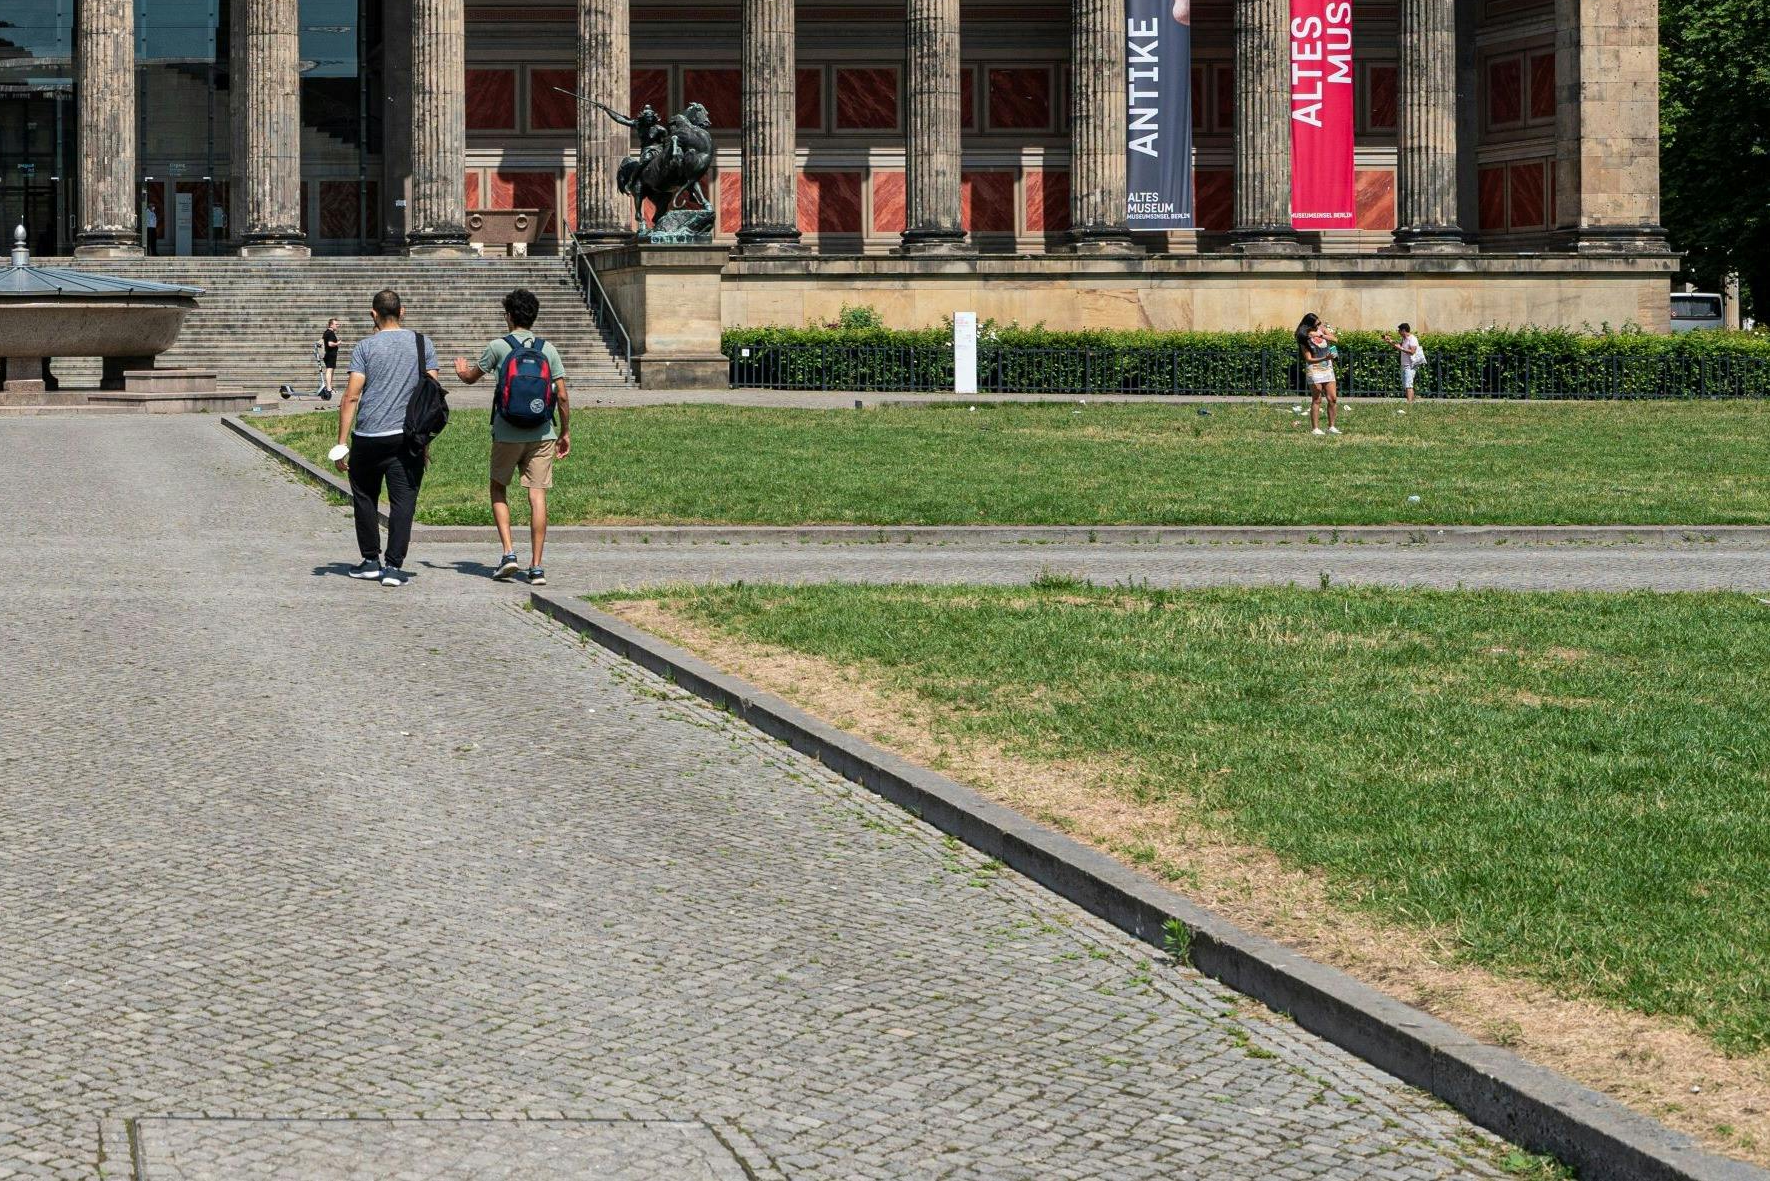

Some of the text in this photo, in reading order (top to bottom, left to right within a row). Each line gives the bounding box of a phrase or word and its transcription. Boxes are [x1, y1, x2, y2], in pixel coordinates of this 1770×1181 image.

[1127, 17, 1159, 157] ANTIKE
[1291, 16, 1323, 127] ALTES
[1127, 203, 1174, 213] MUSEUM
[1128, 192, 1159, 203] ALTES
